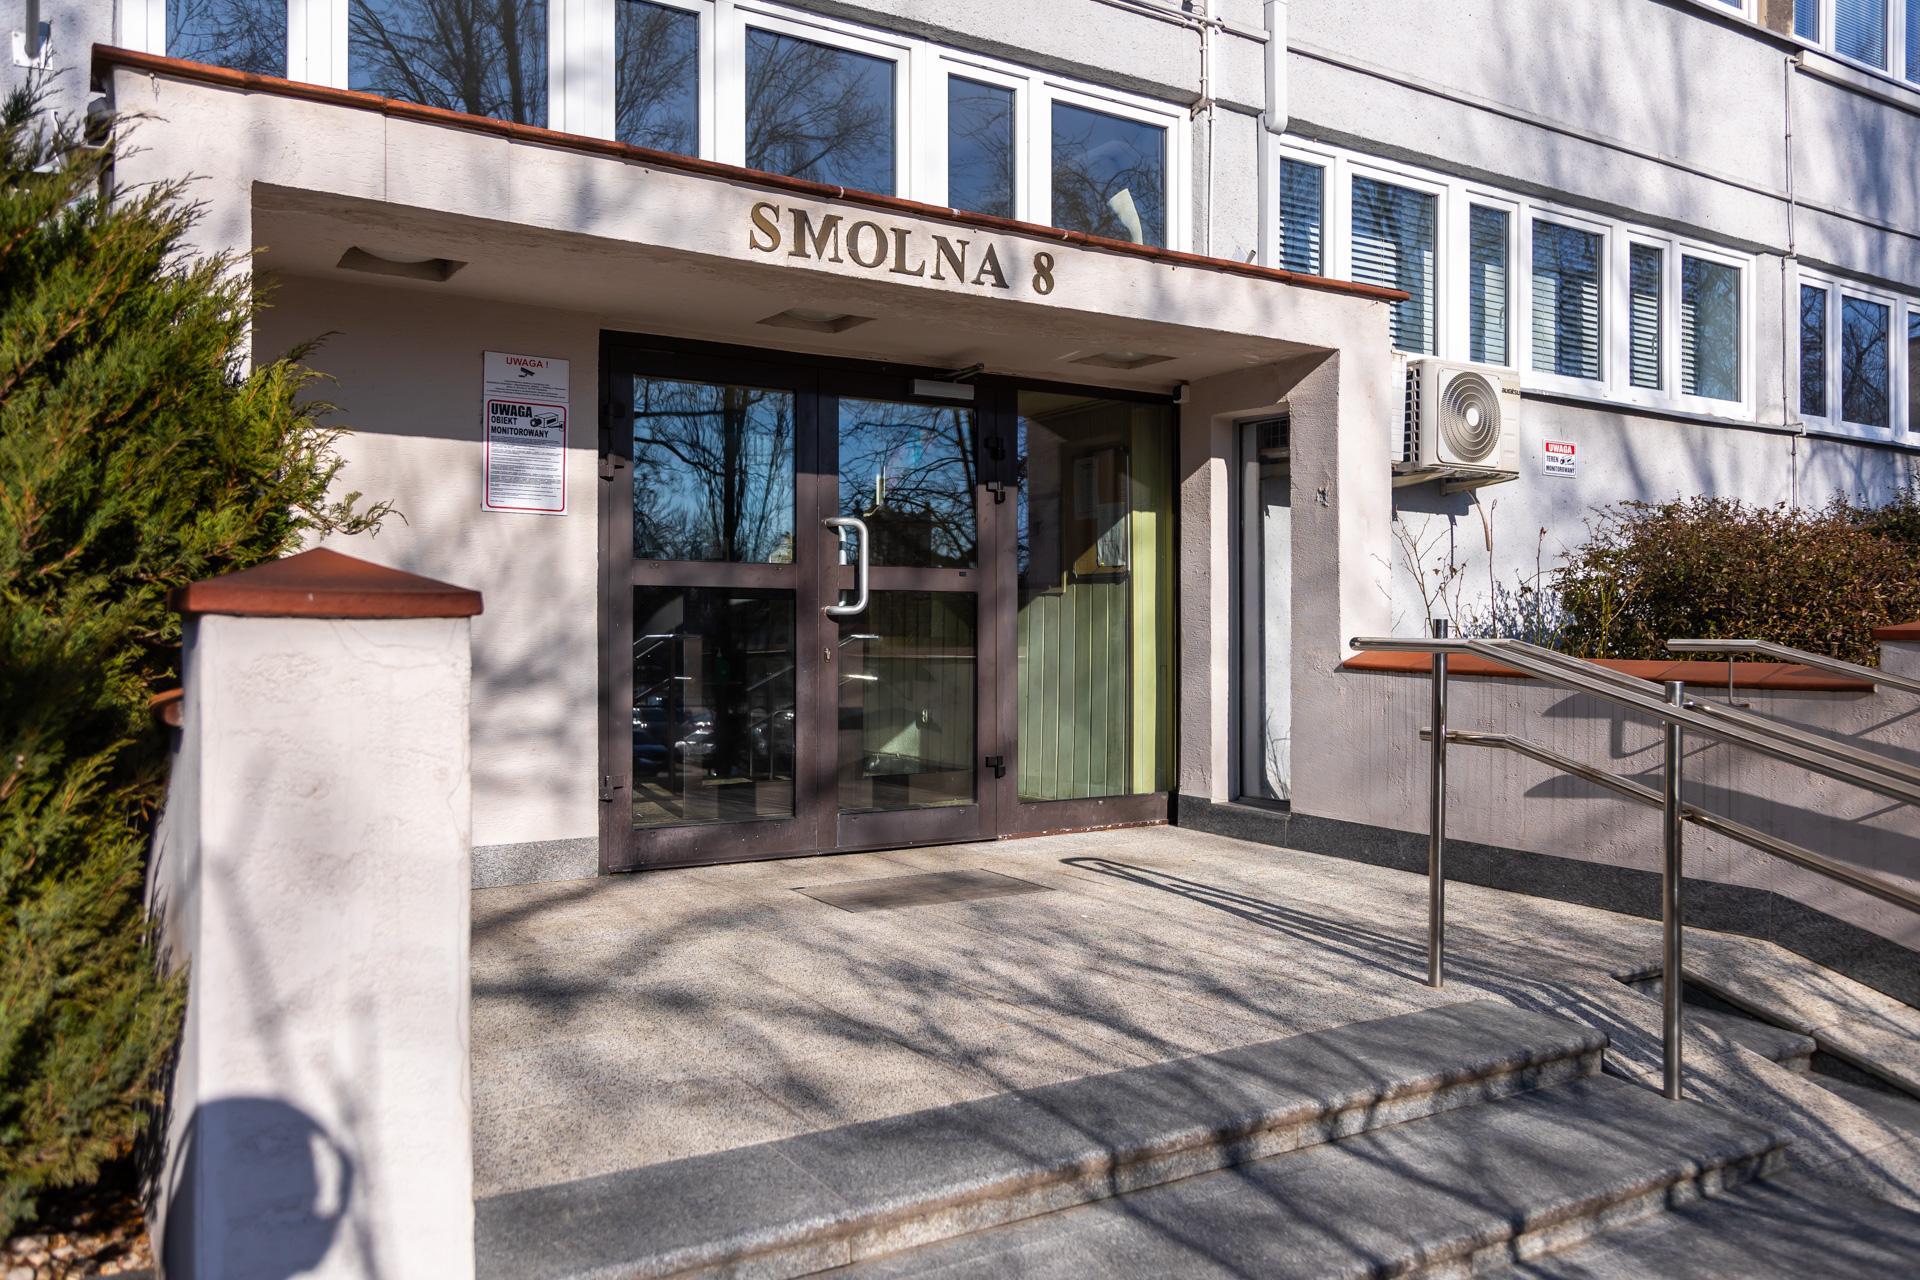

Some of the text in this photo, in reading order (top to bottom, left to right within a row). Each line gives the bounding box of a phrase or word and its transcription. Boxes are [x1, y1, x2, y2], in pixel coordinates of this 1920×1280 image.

[750, 201, 1055, 296] SMOLNA 8
[506, 357, 543, 368] UWAGA
[491, 403, 533, 418] UWAGA
[491, 416, 518, 425] OBIEKT
[491, 426, 549, 438] MONITOROWANY
[1548, 443, 1572, 454] UWAGA
[1546, 455, 1559, 463] TEREN
[1546, 466, 1575, 474] MONITOROWANY
